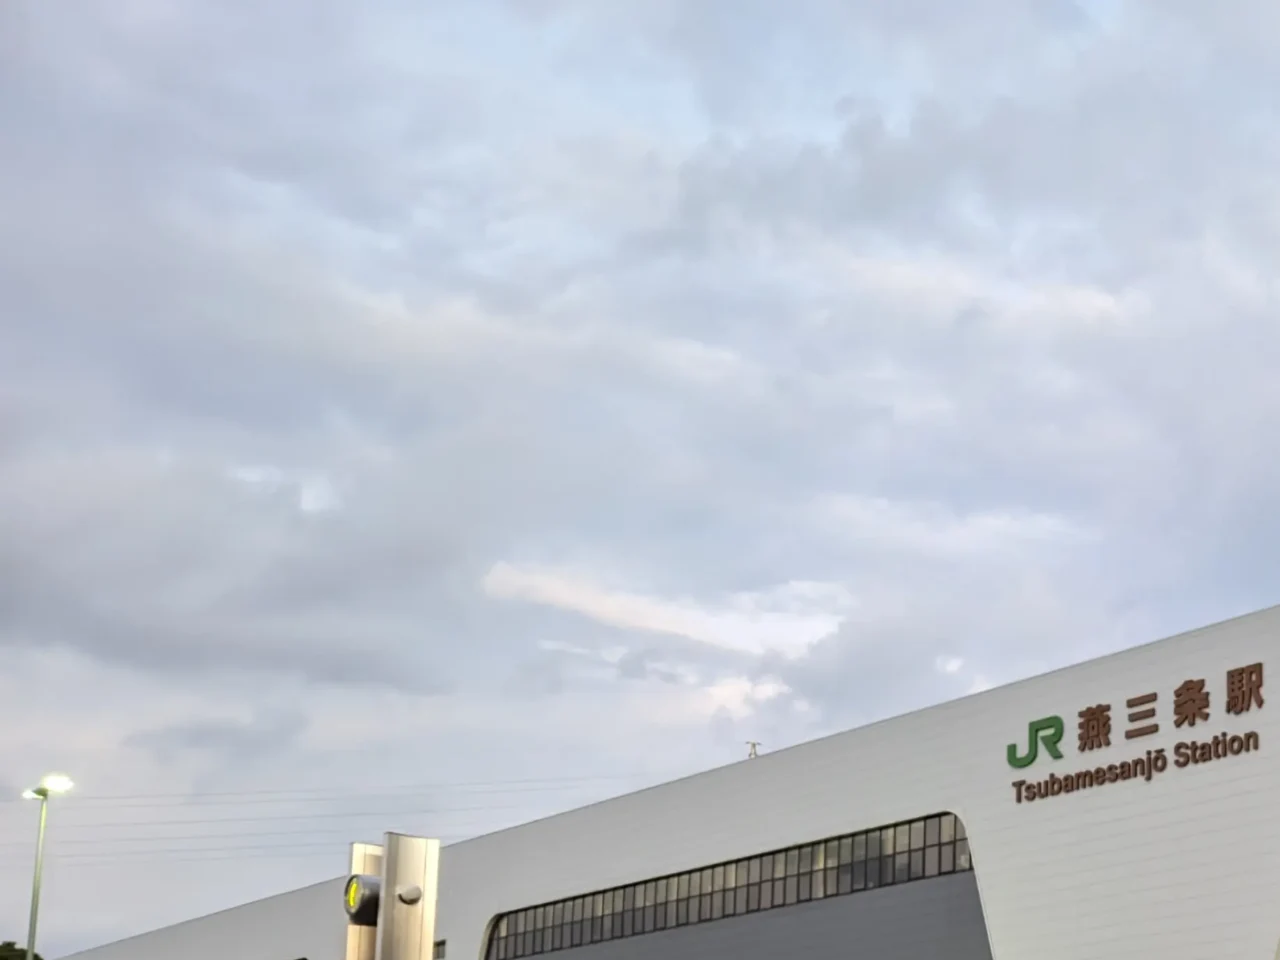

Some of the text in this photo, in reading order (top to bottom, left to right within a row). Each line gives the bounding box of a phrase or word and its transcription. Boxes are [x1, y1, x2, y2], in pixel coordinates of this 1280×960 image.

[1007, 714, 1064, 768] JR
[1077, 662, 1264, 752] 燕三条駅
[1012, 730, 1259, 803] Tsubamesanjō Station
